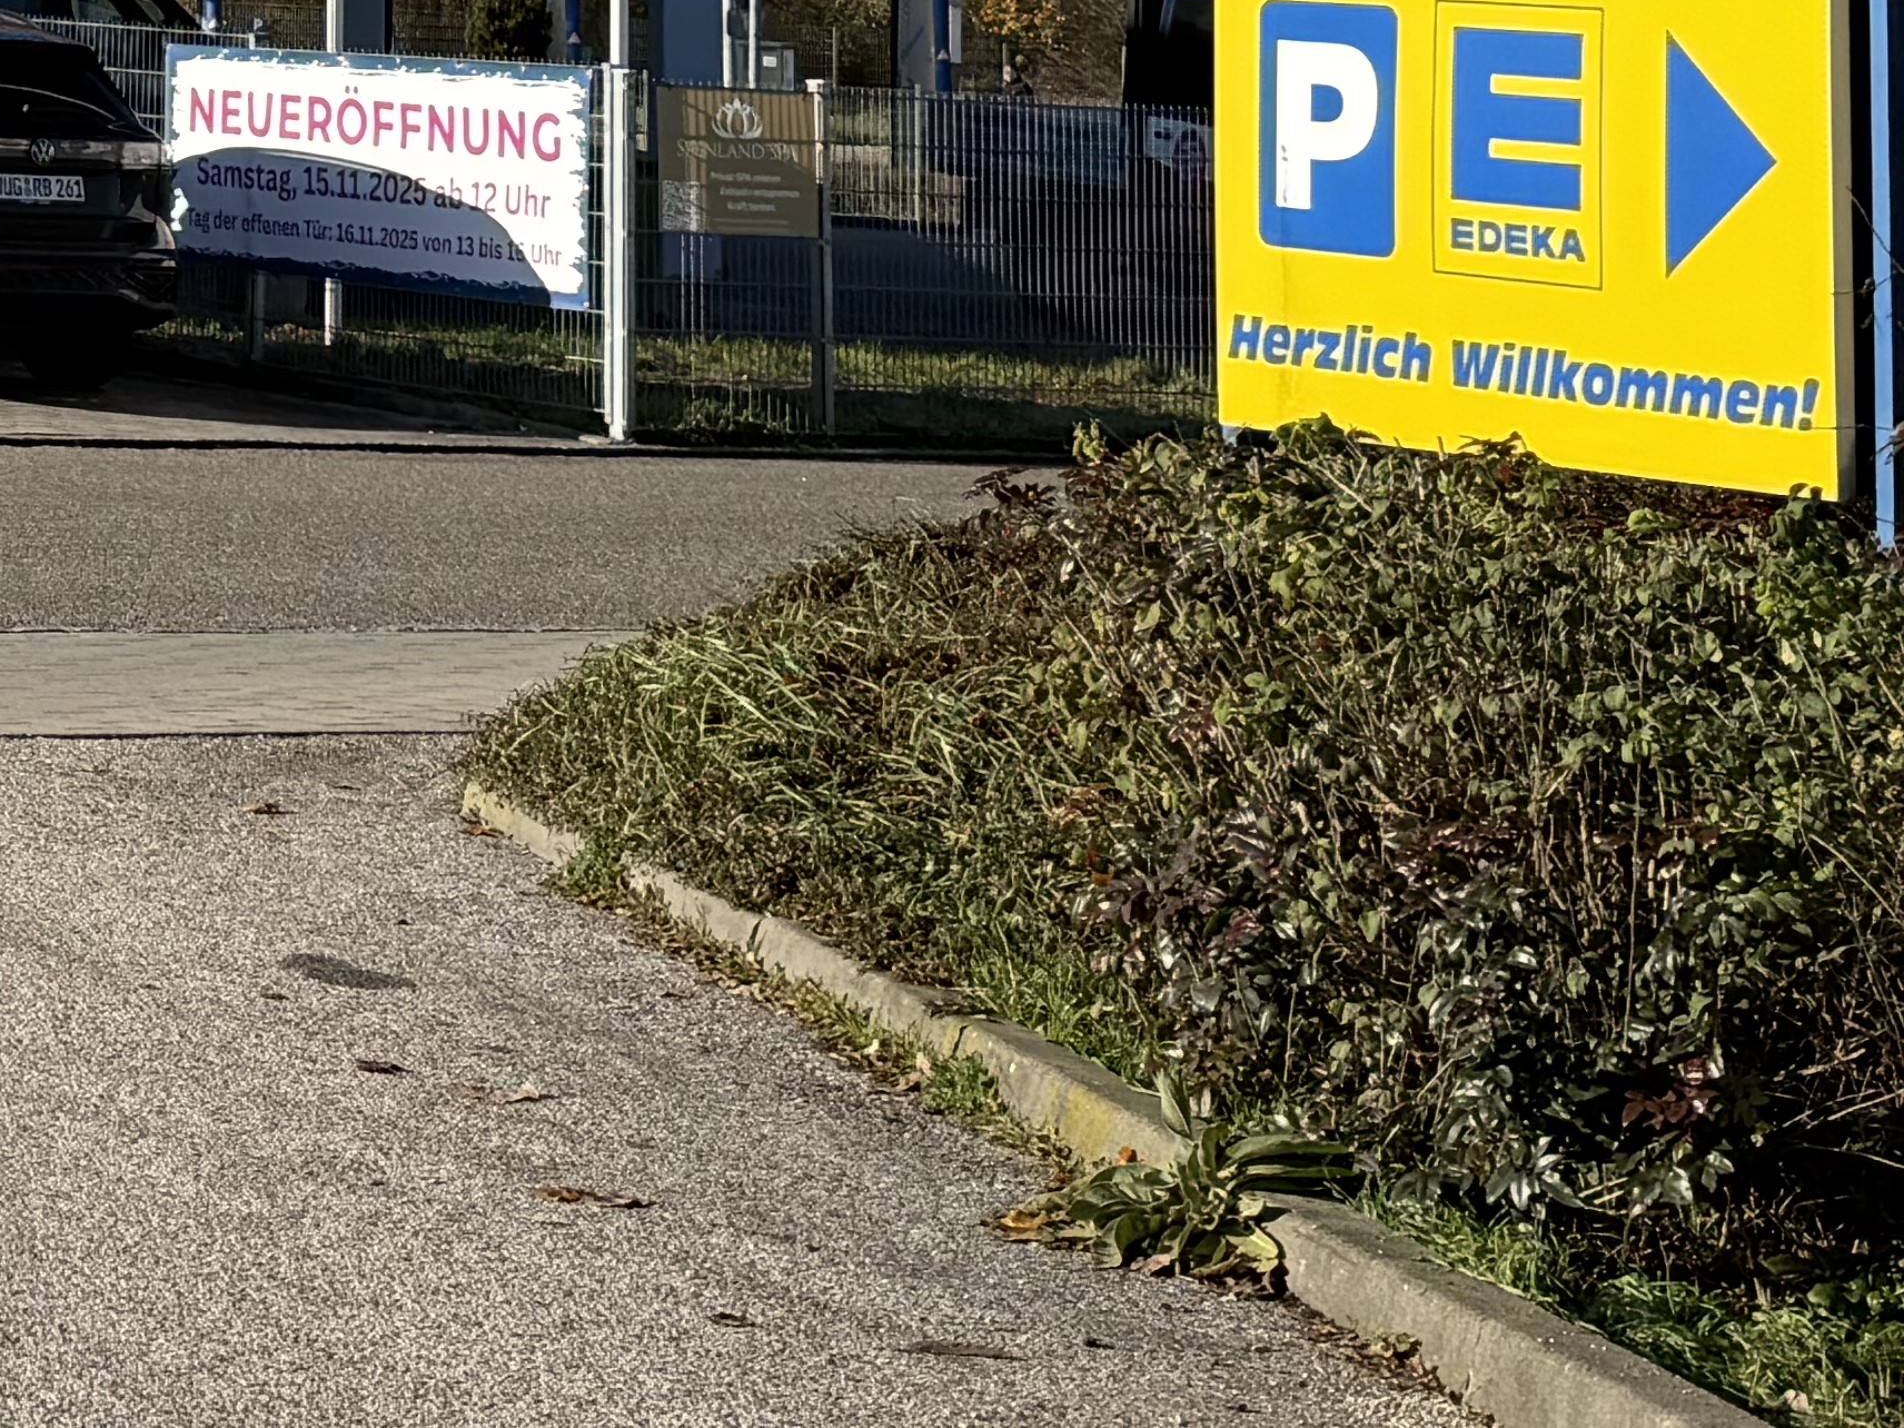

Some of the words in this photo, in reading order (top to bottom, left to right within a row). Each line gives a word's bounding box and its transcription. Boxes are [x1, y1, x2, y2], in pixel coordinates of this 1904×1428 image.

[189, 85, 562, 162] NEUERÖFFNUNG
[1275, 38, 1379, 210] P
[1450, 26, 1584, 211] E
[33, 177, 53, 198] RB
[55, 178, 83, 199] 261
[196, 156, 297, 201] Samstag,
[303, 165, 427, 206] 15.11.2025
[433, 176, 463, 210] ab
[471, 181, 497, 213] 12
[505, 184, 552, 219] Uhr
[188, 208, 210, 234] Tag
[213, 209, 239, 232] der
[241, 212, 300, 239] offenen
[303, 219, 333, 240] Tür:
[335, 222, 419, 251] 16.11.2025
[422, 235, 452, 254] von
[456, 235, 475, 257] 13
[479, 236, 503, 260] bis
[531, 242, 562, 266] Uhr
[1449, 217, 1586, 263] EDEKA
[1227, 314, 1432, 384] Herzlich
[1451, 339, 1820, 431] Willkommen!
